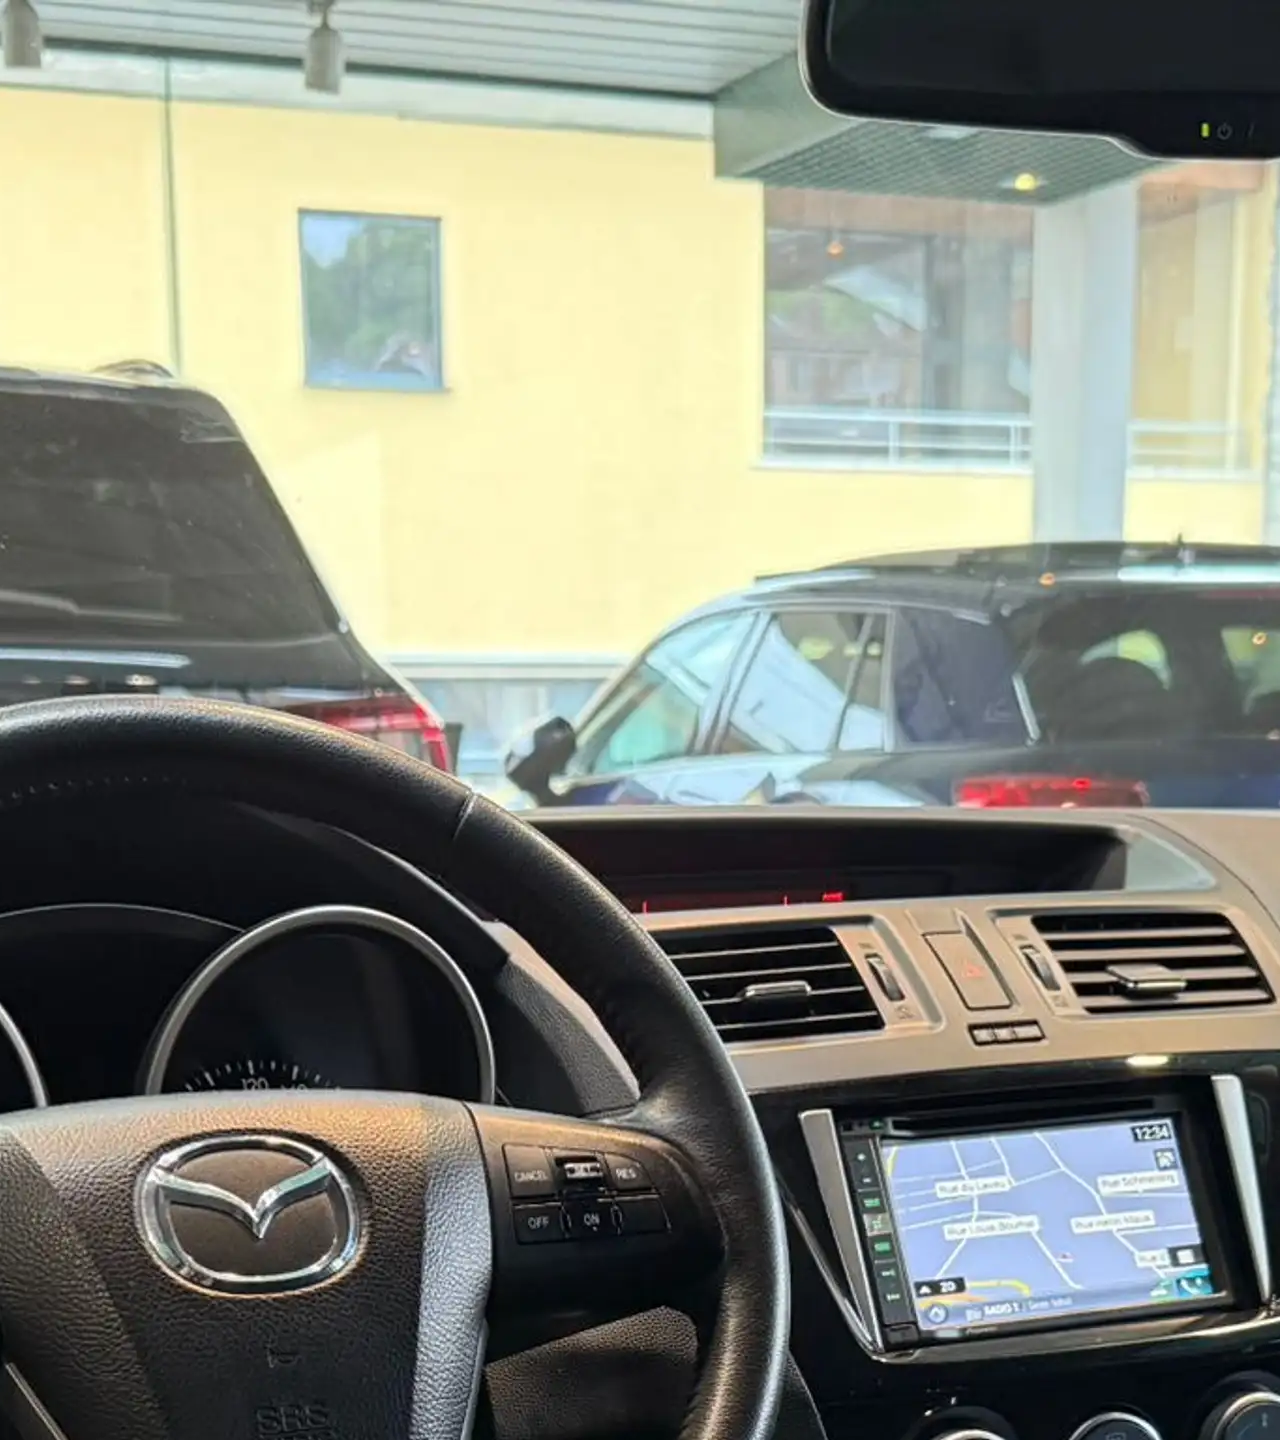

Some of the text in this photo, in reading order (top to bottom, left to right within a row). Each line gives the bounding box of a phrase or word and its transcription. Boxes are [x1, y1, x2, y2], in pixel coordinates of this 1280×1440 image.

[514, 1169, 549, 1183] CANCEL
[615, 1167, 638, 1180] RES
[527, 1216, 550, 1230] OFF
[583, 1213, 600, 1227] ON
[255, 1403, 331, 1433] SRS
